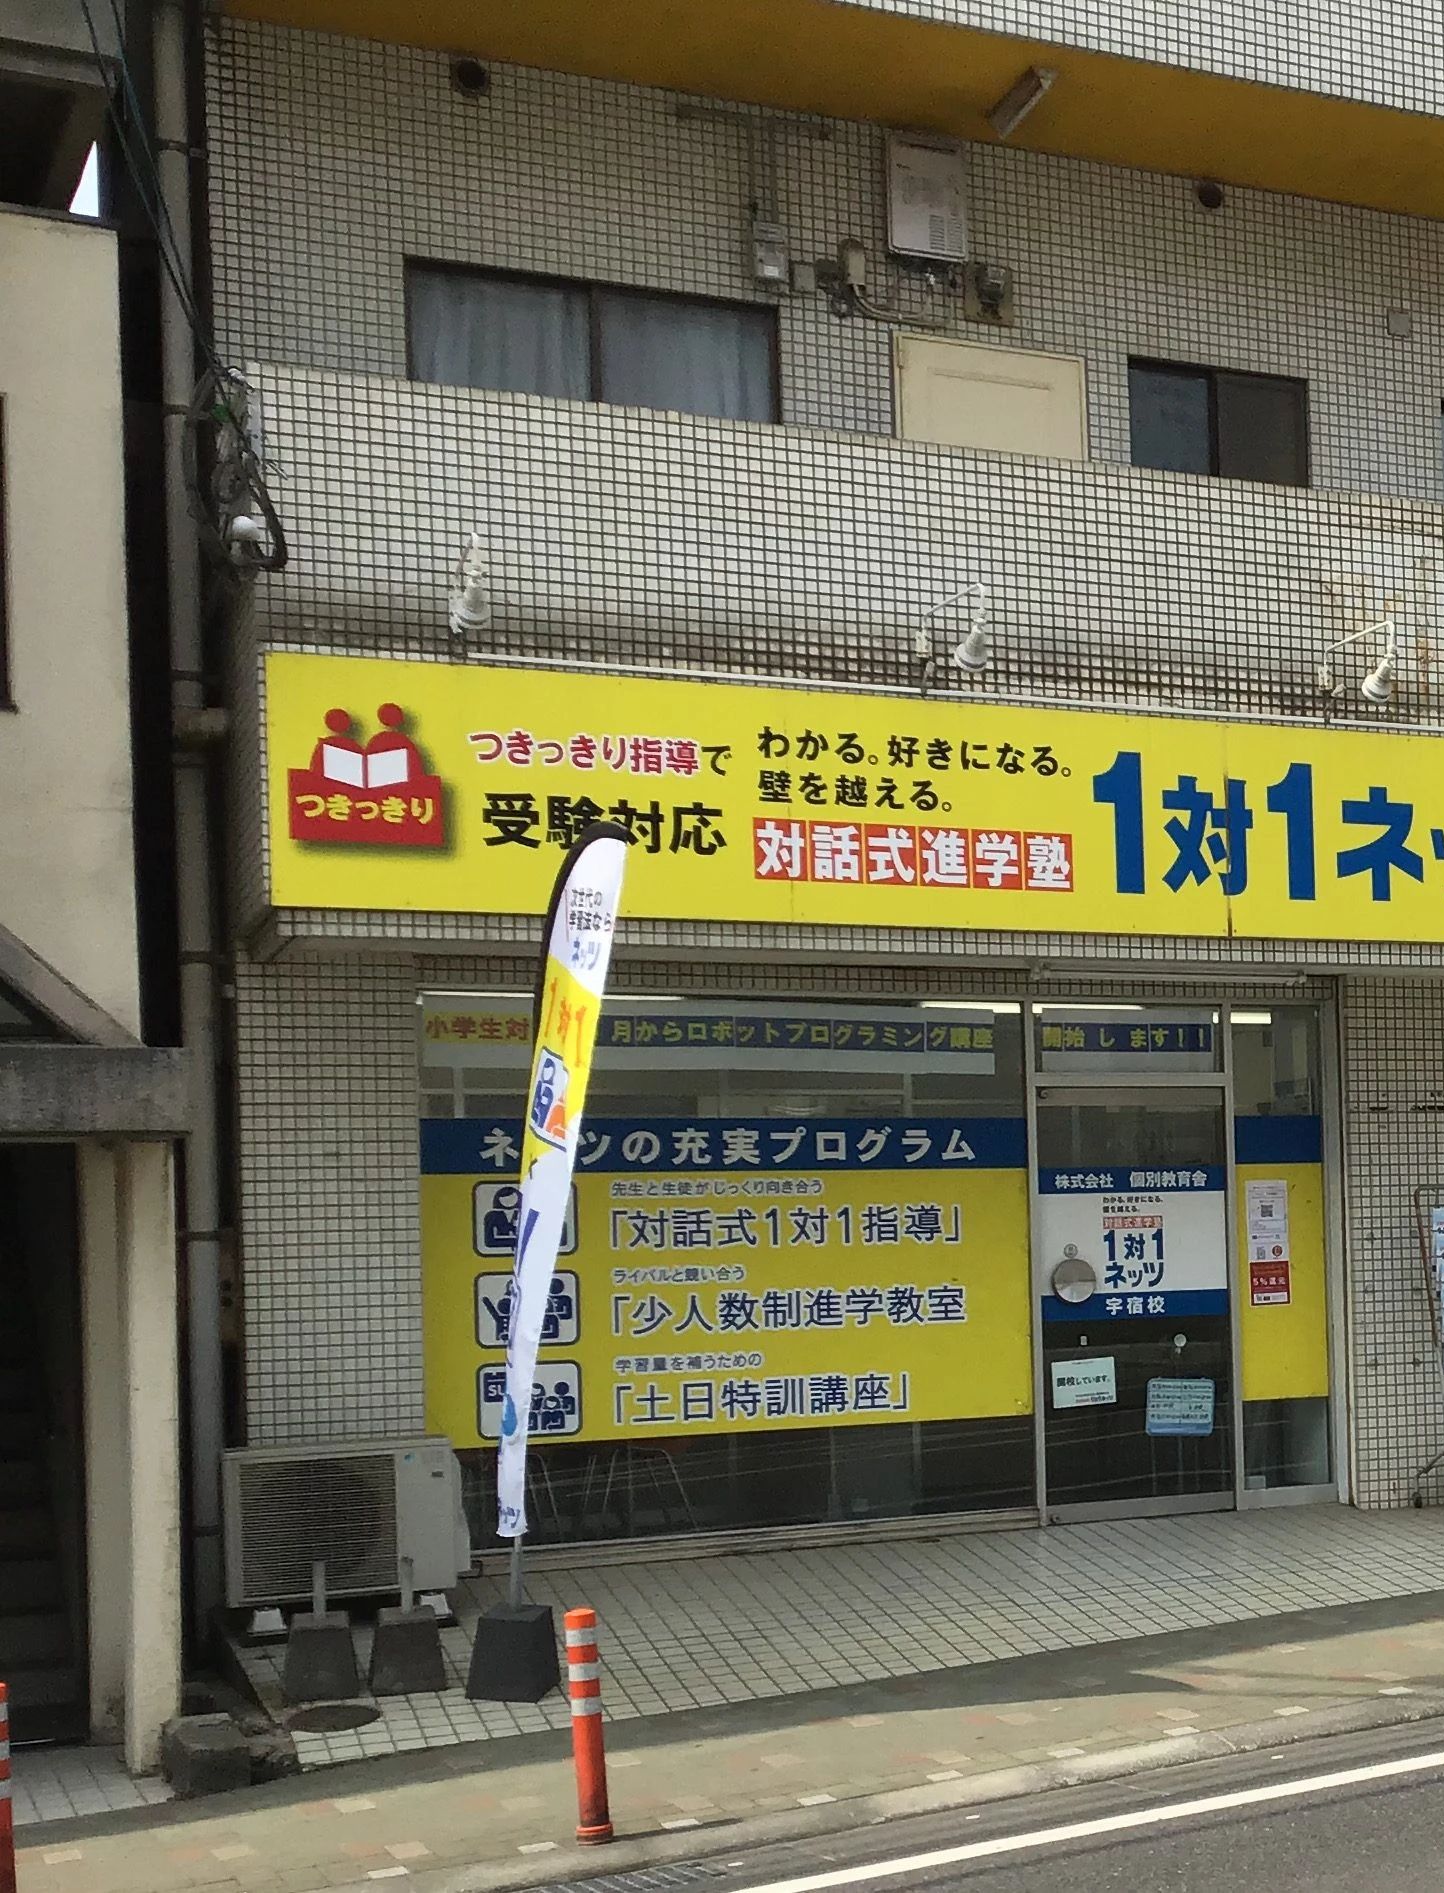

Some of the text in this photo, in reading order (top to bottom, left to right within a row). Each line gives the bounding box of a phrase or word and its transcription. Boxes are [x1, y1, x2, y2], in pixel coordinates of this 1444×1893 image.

[468, 730, 732, 777] つきっきり指導で
[757, 726, 1072, 778] わかる。好きになる。
[758, 770, 952, 812] 壁を越える。
[295, 793, 434, 826] つきっきり
[482, 793, 726, 855] 受験対応
[756, 820, 1070, 889] 対話式進学塾
[426, 1014, 530, 1041] 小学生対
[611, 1016, 994, 1050] 月からロボットプログラミング講座
[480, 1126, 977, 1168] ネツの充実プログラム
[612, 1179, 823, 1197] 先生と生徒がじっくり向き合う
[1055, 1170, 1207, 1189] 株式会社 個別教育舎
[610, 1205, 962, 1251] 「対話式1対1指導」
[1103, 1228, 1164, 1261] 1対1
[613, 1265, 746, 1285] ライバルと競い合う
[1104, 1262, 1164, 1289] ネッツ
[1105, 1296, 1165, 1316] 宇宿校
[615, 1352, 763, 1373] 学習量を補うための
[612, 1374, 910, 1425] 「土日特訓講座」
